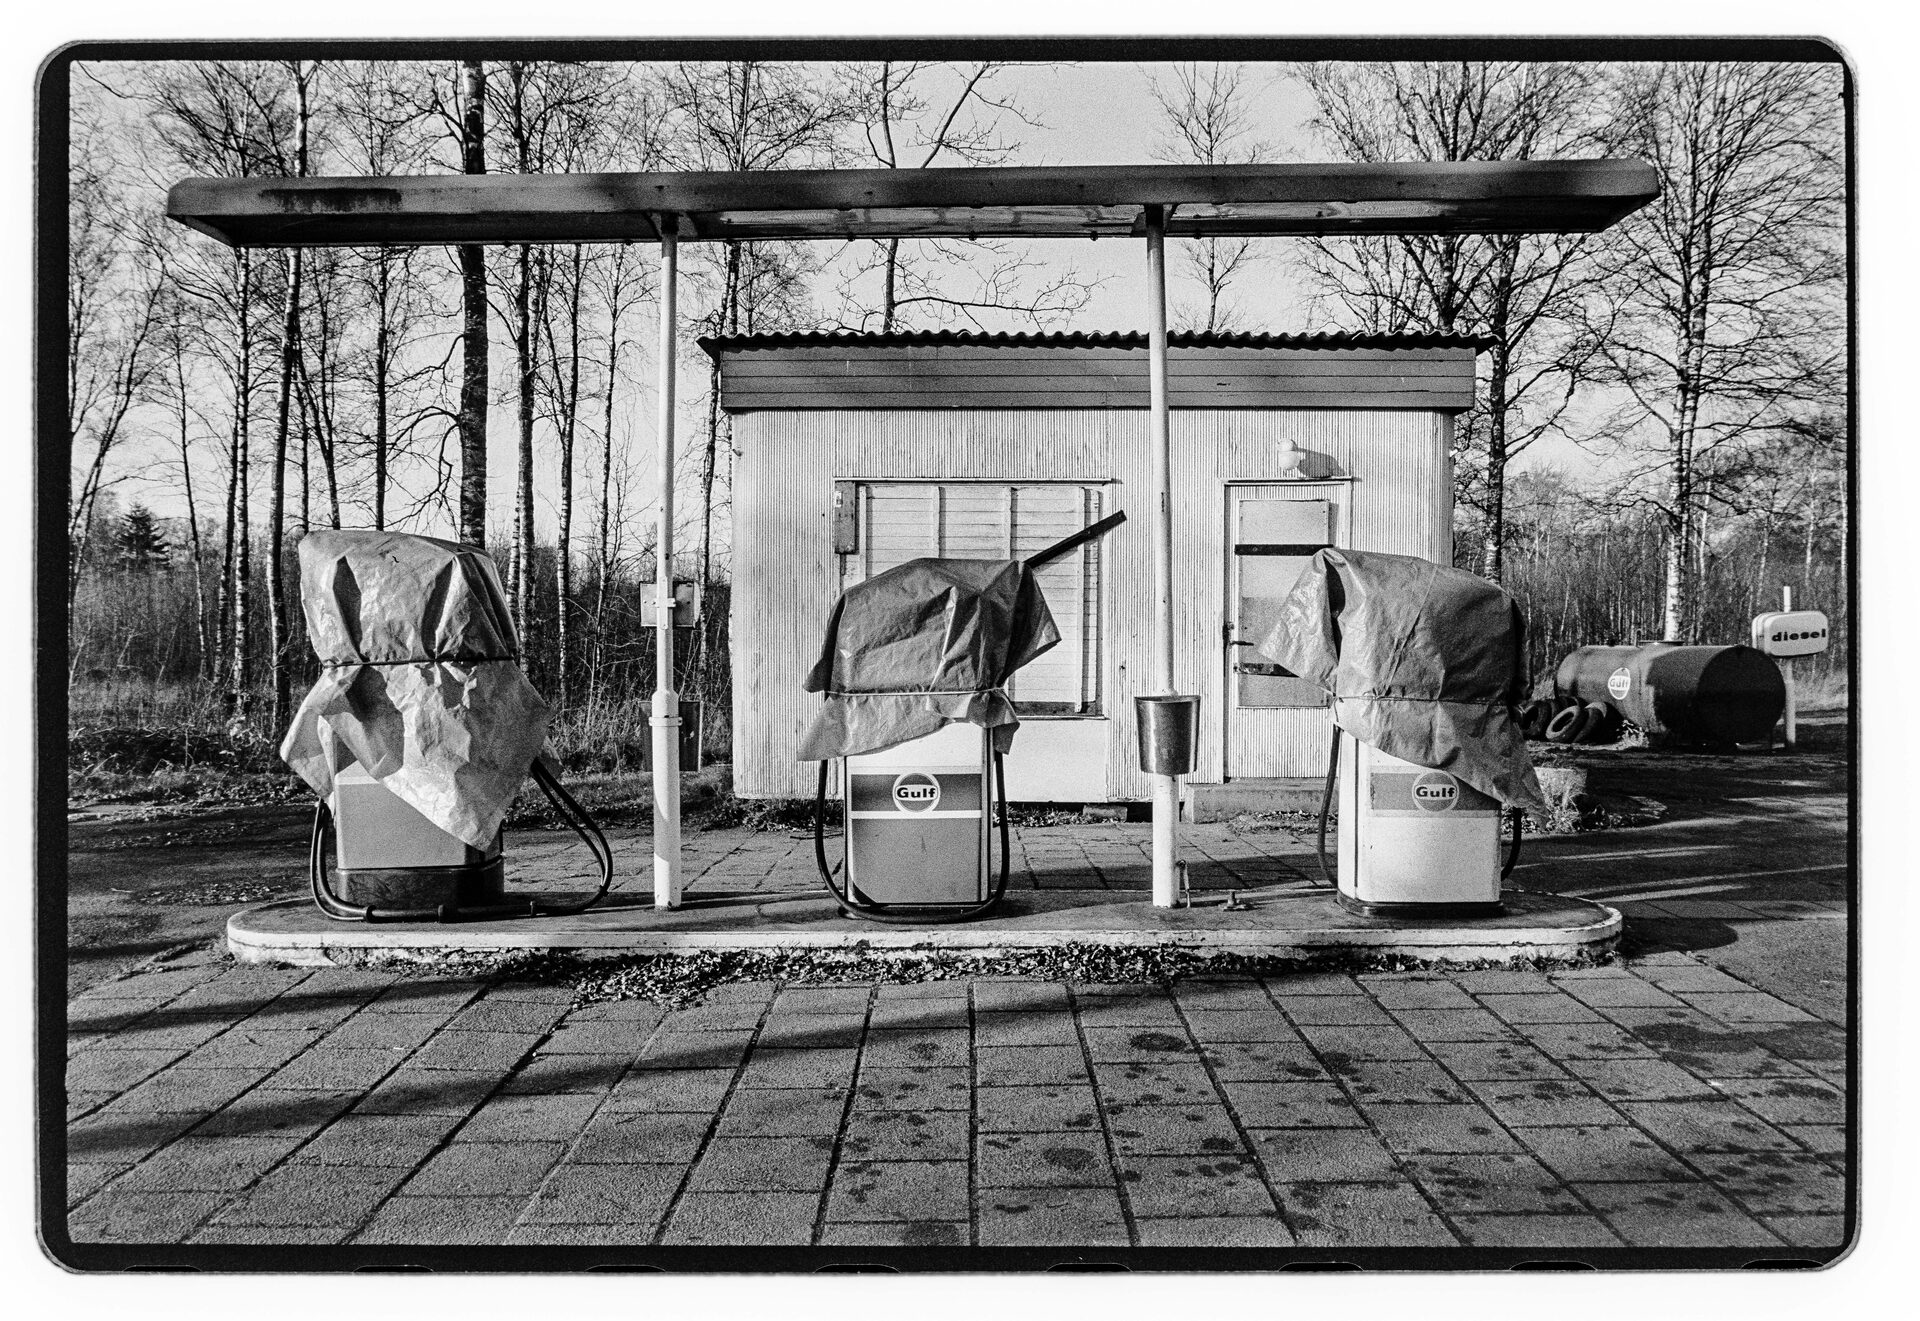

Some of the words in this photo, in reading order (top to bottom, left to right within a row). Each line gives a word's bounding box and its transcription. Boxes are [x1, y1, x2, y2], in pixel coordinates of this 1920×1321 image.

[1772, 628, 1826, 642] diesel
[897, 787, 936, 798] Gulf
[1416, 786, 1455, 798] Gulf
